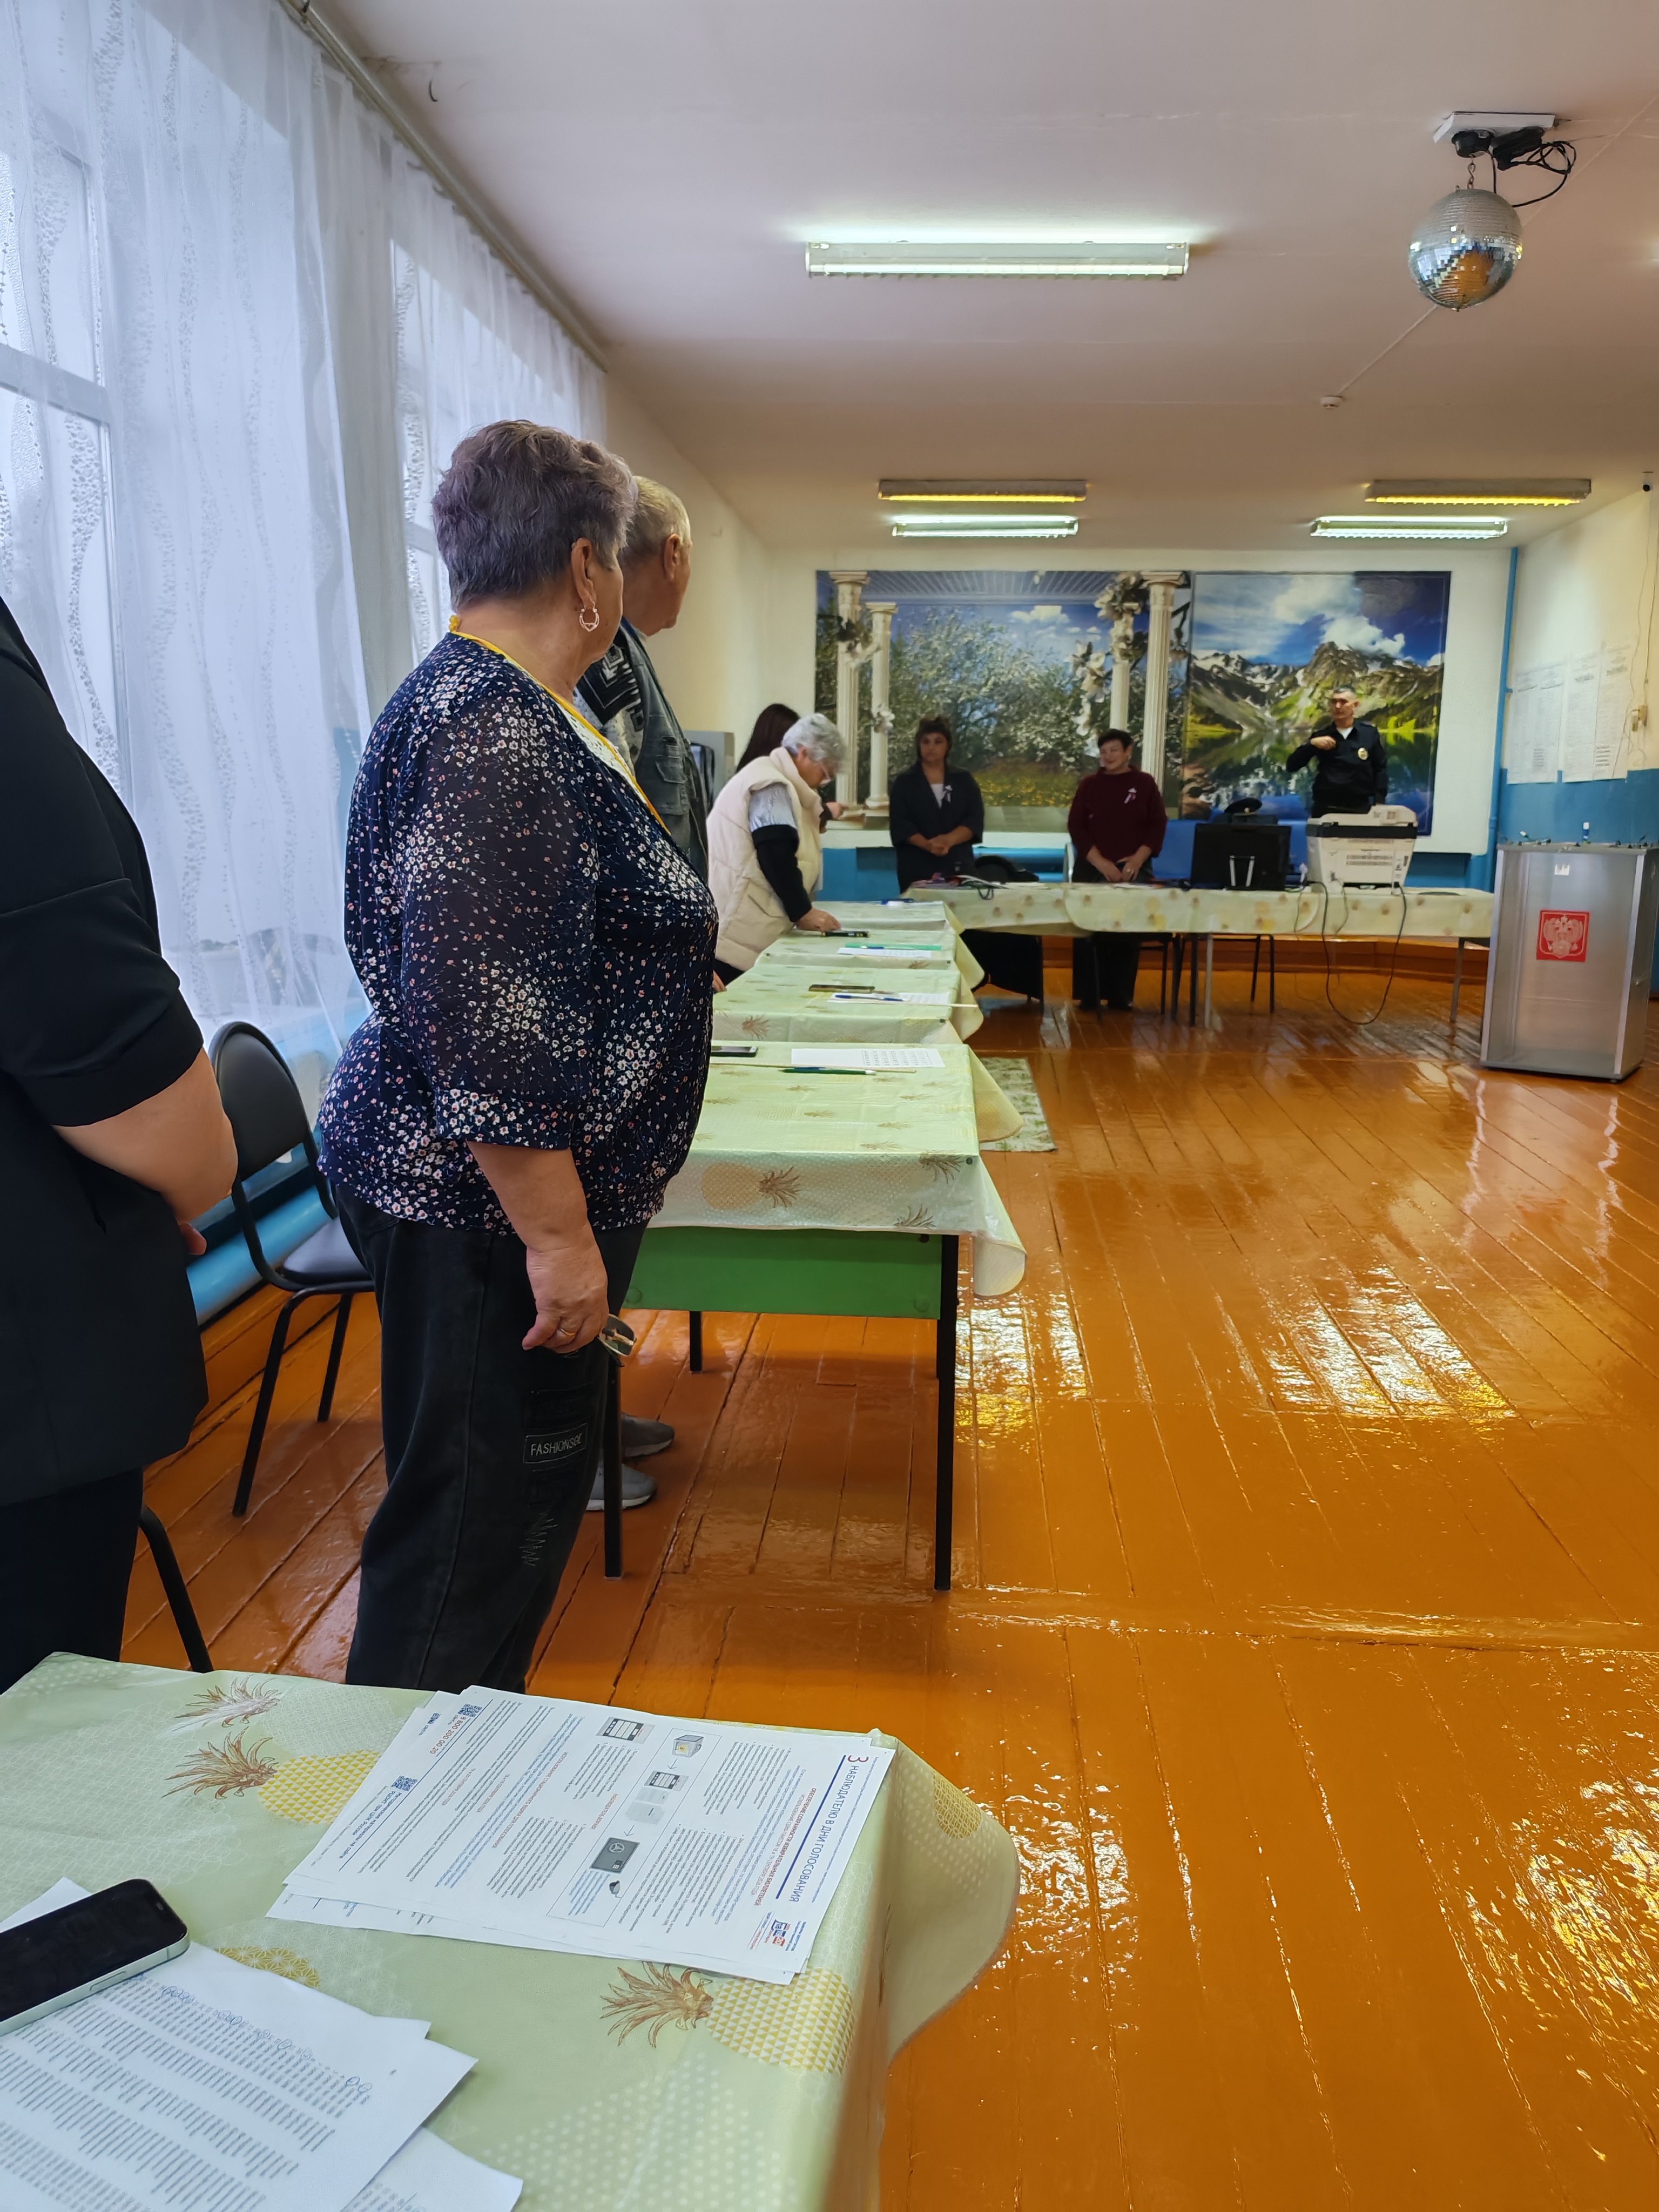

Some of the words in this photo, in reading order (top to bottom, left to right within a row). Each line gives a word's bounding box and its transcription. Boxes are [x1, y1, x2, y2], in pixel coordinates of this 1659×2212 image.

[443, 1730, 454, 1739] 200
[451, 1720, 463, 1729] 800
[799, 1788, 817, 1813] ОБЕСПЕЧЕНИЕ
[828, 1765, 859, 1818] НАБЛЮДАТЕЛЮ
[375, 1792, 402, 1819] Методические
[355, 1819, 376, 1841] материалы
[786, 1813, 804, 1842] СОХРАННОСТИ
[817, 1825, 832, 1842] ДНИ
[768, 1842, 790, 1877] ИЗБИРАТЕЛЬНЫХ
[789, 1843, 824, 1902] ГОЛОСОВАНИЯ
[754, 1877, 773, 1906] БЮЛЛЕТЕНЕЙ
